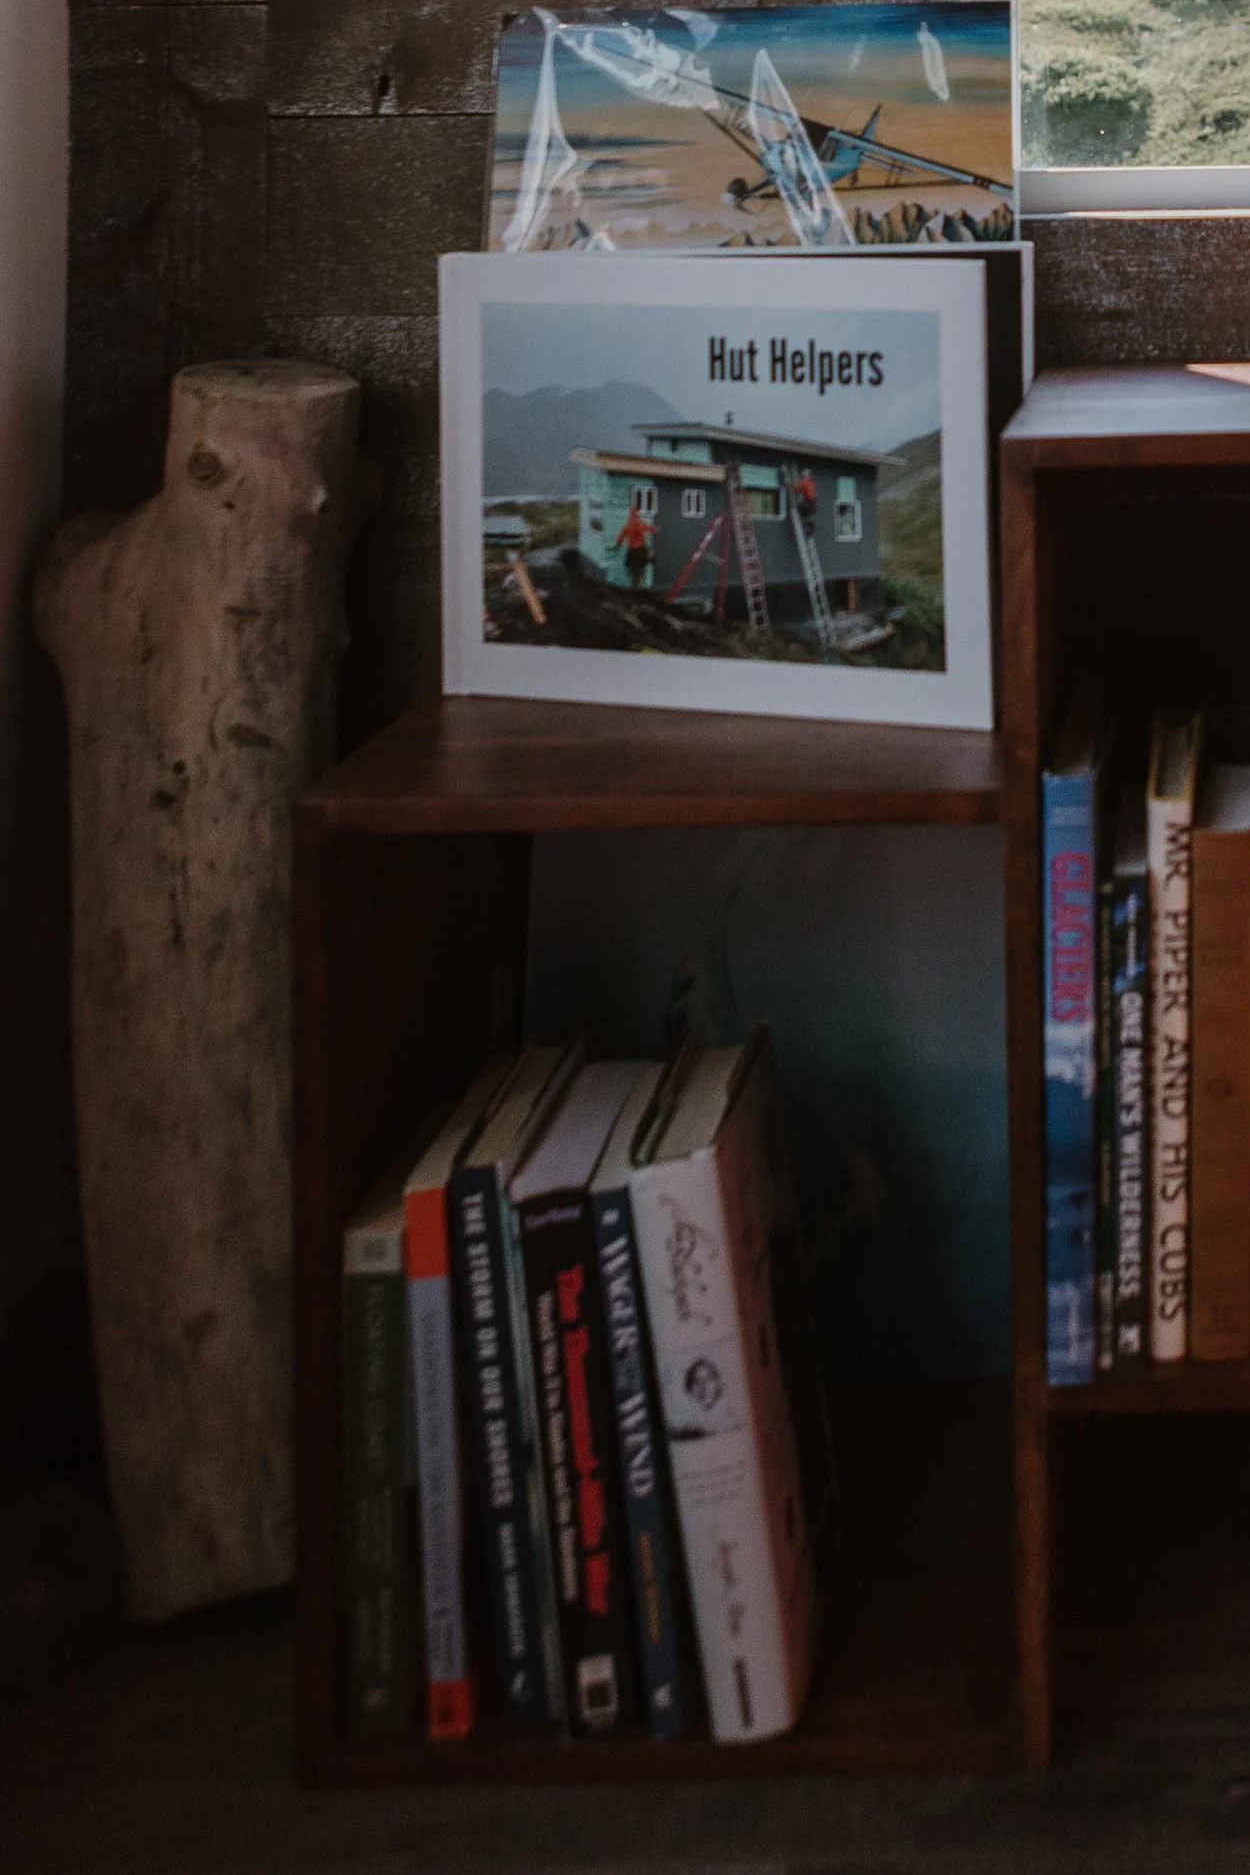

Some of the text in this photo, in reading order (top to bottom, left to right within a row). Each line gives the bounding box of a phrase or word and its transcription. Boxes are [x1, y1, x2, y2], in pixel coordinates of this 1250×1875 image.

[709, 337, 884, 395] Hut Helpers
[1051, 849, 1094, 1021] GLACIERS
[1162, 908, 1191, 1014] PIPER
[1118, 990, 1144, 1044] ONE
[1161, 1034, 1190, 1120] AND
[1118, 1129, 1143, 1298] WILDERNESS
[1161, 1141, 1189, 1202] HIS
[1160, 1222, 1189, 1322] CUBS
[462, 1191, 515, 1507] THE STORM ON OUR SHORES
[617, 1391, 655, 1497] WIND
